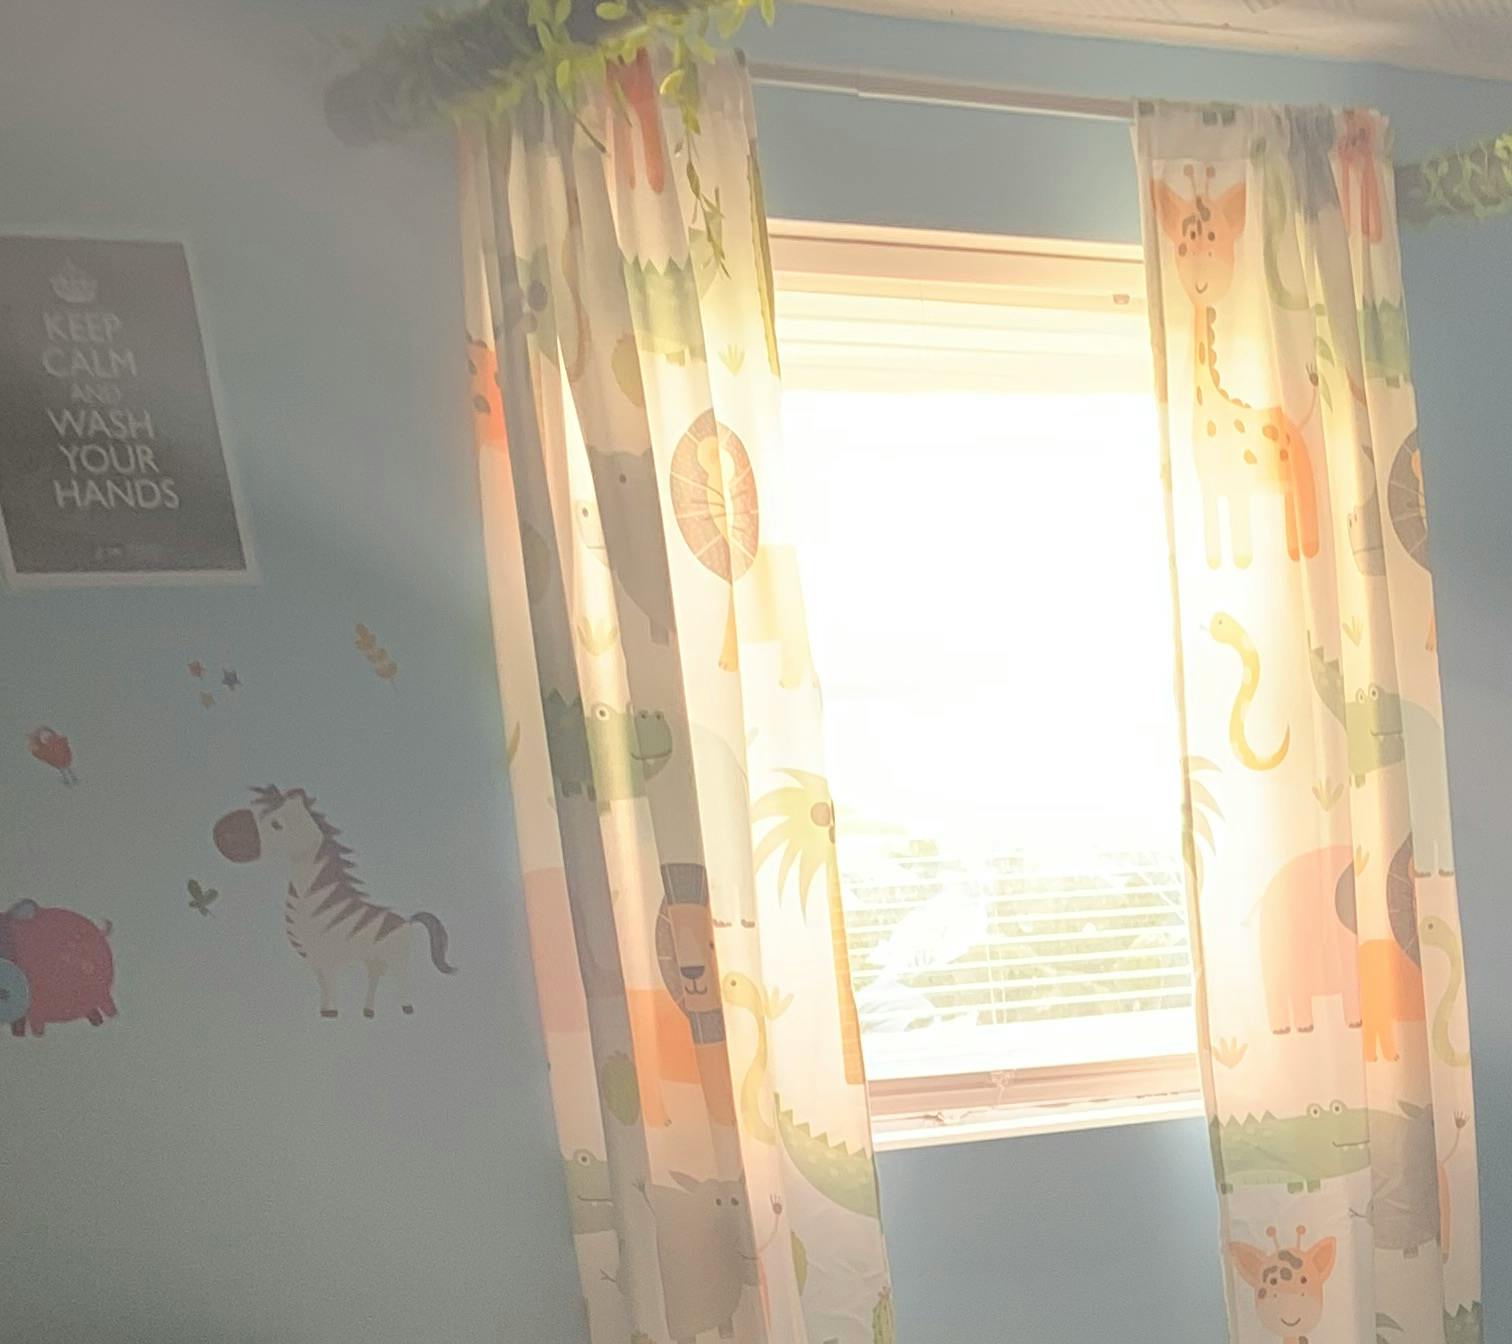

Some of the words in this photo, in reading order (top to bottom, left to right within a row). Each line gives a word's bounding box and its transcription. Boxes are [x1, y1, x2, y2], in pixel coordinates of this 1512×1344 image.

[43, 313, 121, 342] KEEP
[43, 348, 137, 377] CALM
[48, 409, 154, 440] WASH
[60, 445, 160, 474] YOUR
[54, 479, 180, 510] HANDS
